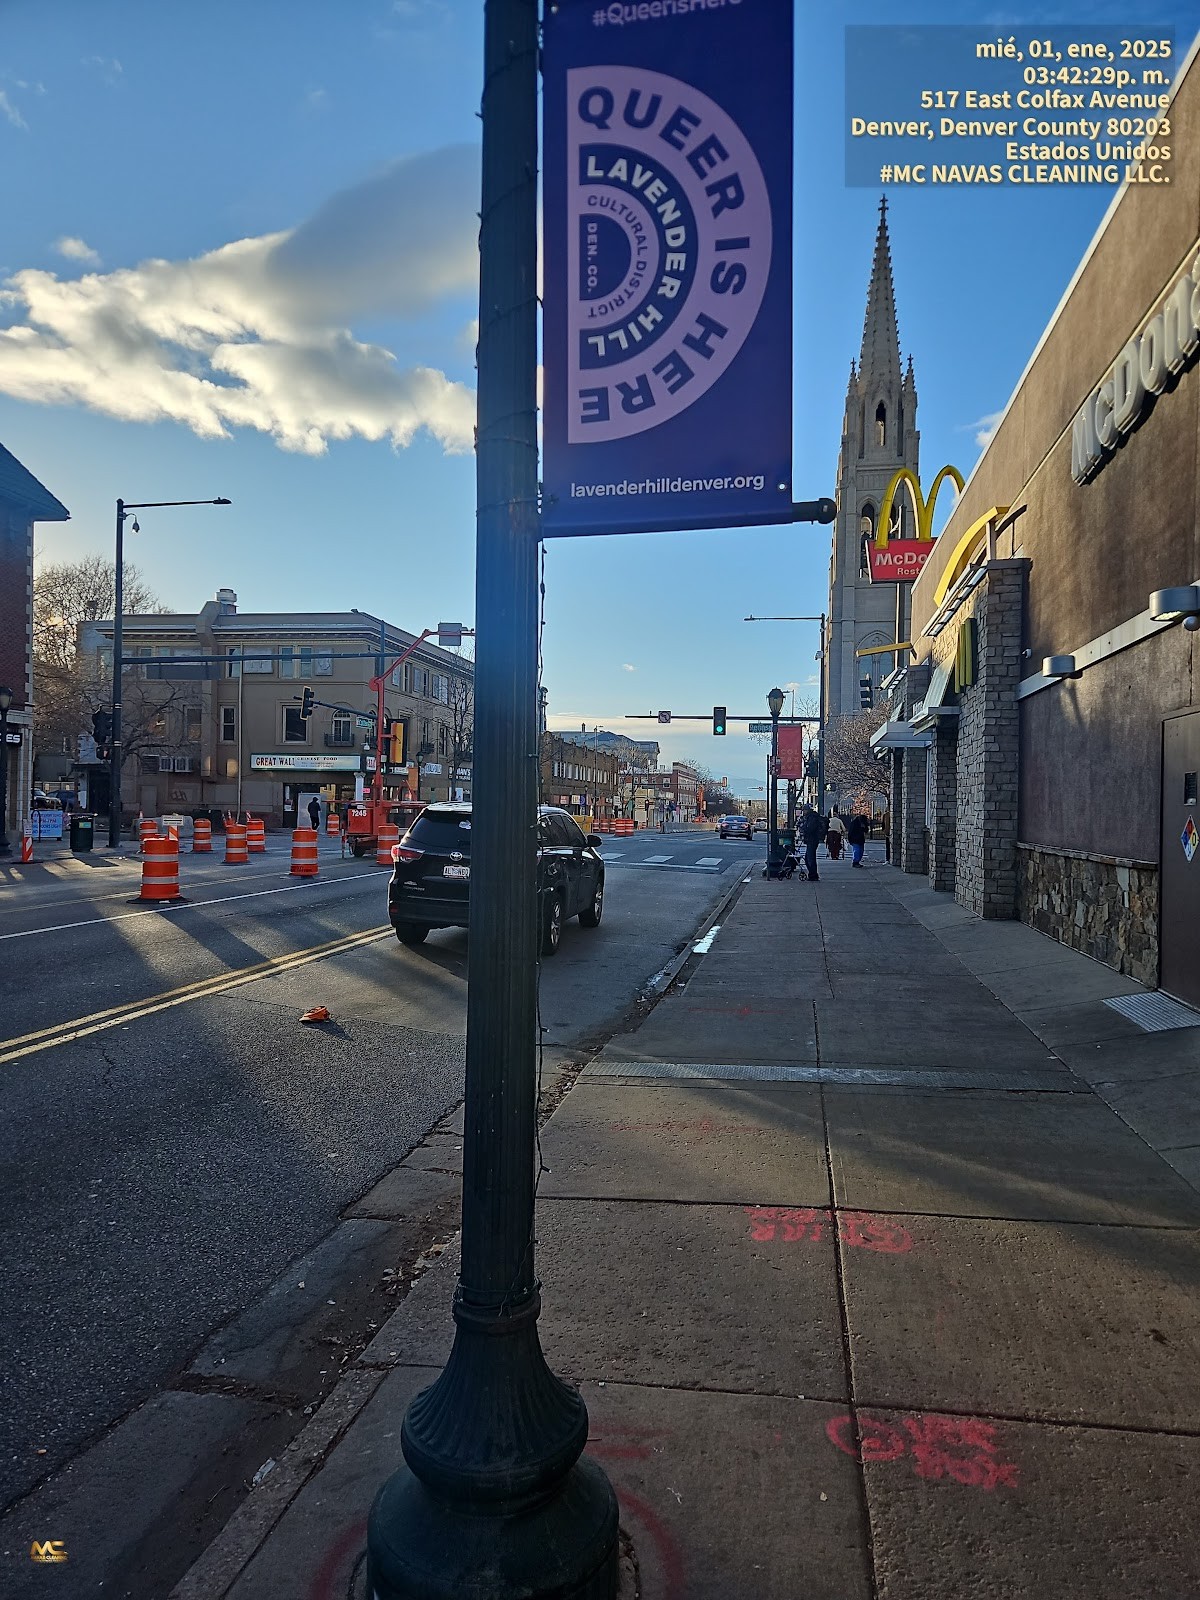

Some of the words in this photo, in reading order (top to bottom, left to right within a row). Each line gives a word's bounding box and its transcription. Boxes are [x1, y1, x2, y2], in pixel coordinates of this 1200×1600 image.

[577, 85, 746, 219] QUEER
[587, 195, 649, 256] CULTURAL
[587, 156, 687, 299] LAVENDER
[587, 222, 598, 261] DEN.
[587, 265, 598, 293] CO.
[588, 260, 648, 319] DISTRICT
[710, 236, 747, 295] IS
[588, 303, 664, 357] HILL
[578, 312, 729, 424] HERE
[570, 475, 765, 497] lavenderhilldenver.org
[255, 757, 277, 766] GREAT
